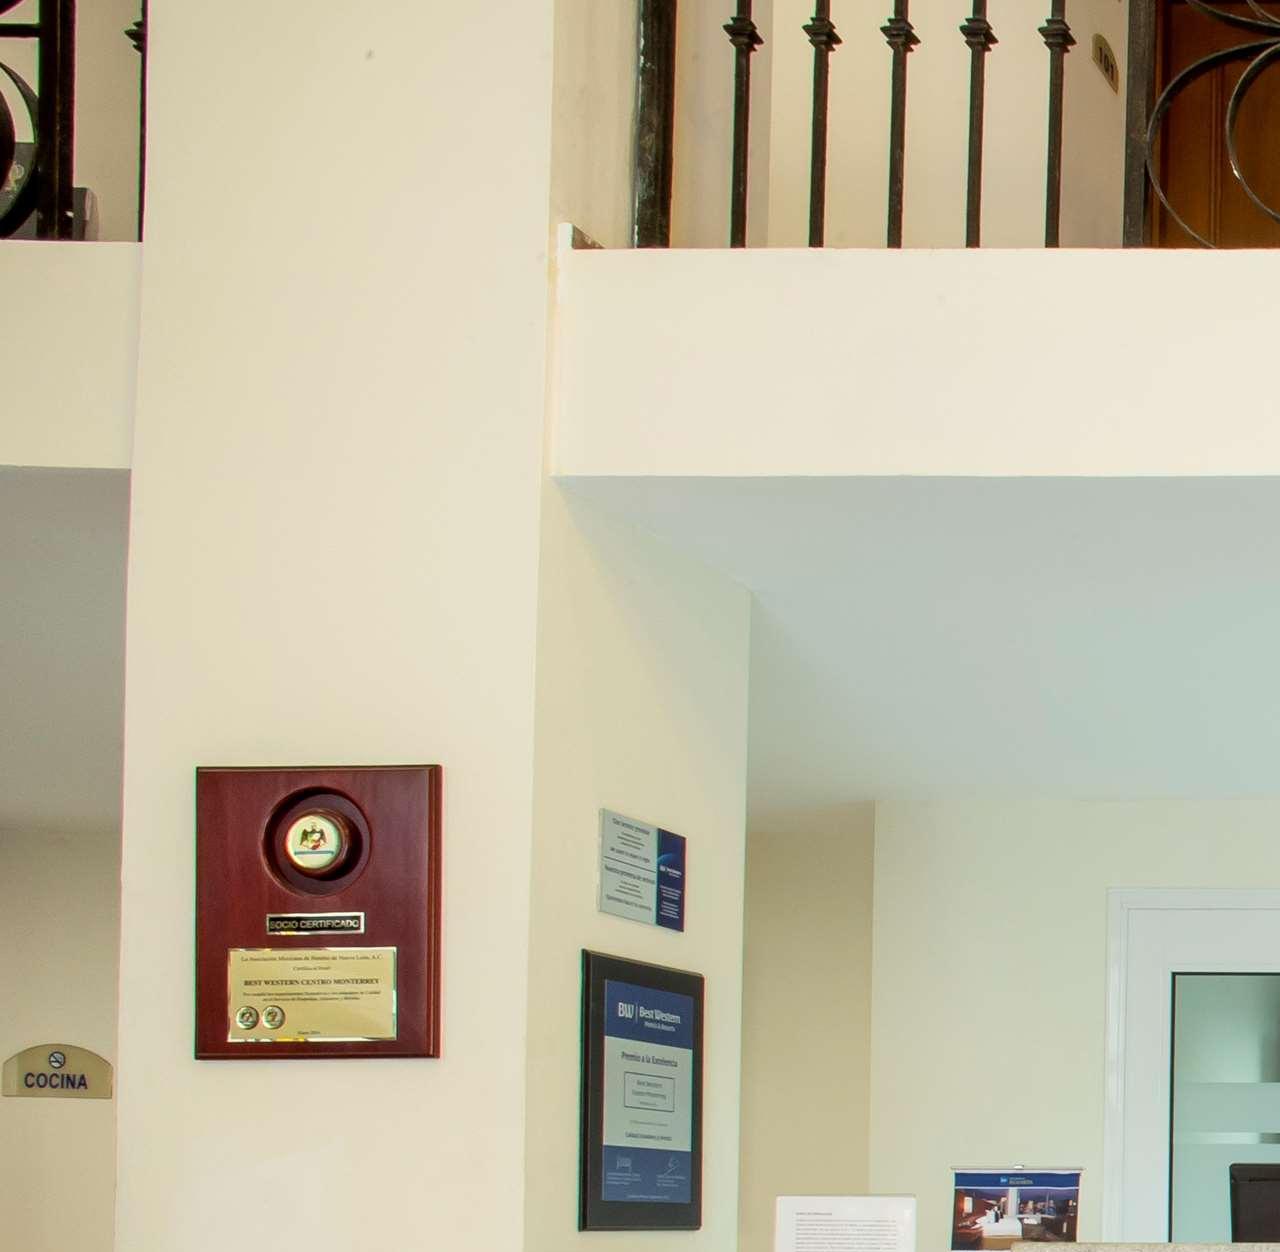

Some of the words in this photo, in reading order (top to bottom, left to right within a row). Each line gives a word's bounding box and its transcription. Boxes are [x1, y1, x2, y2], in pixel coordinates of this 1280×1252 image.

[270, 920, 298, 929] SOCIO
[300, 920, 359, 929] CERTIFICADO
[618, 1002, 634, 1019] BW
[640, 1006, 654, 1019] Best
[24, 1072, 88, 1089] COCINA
